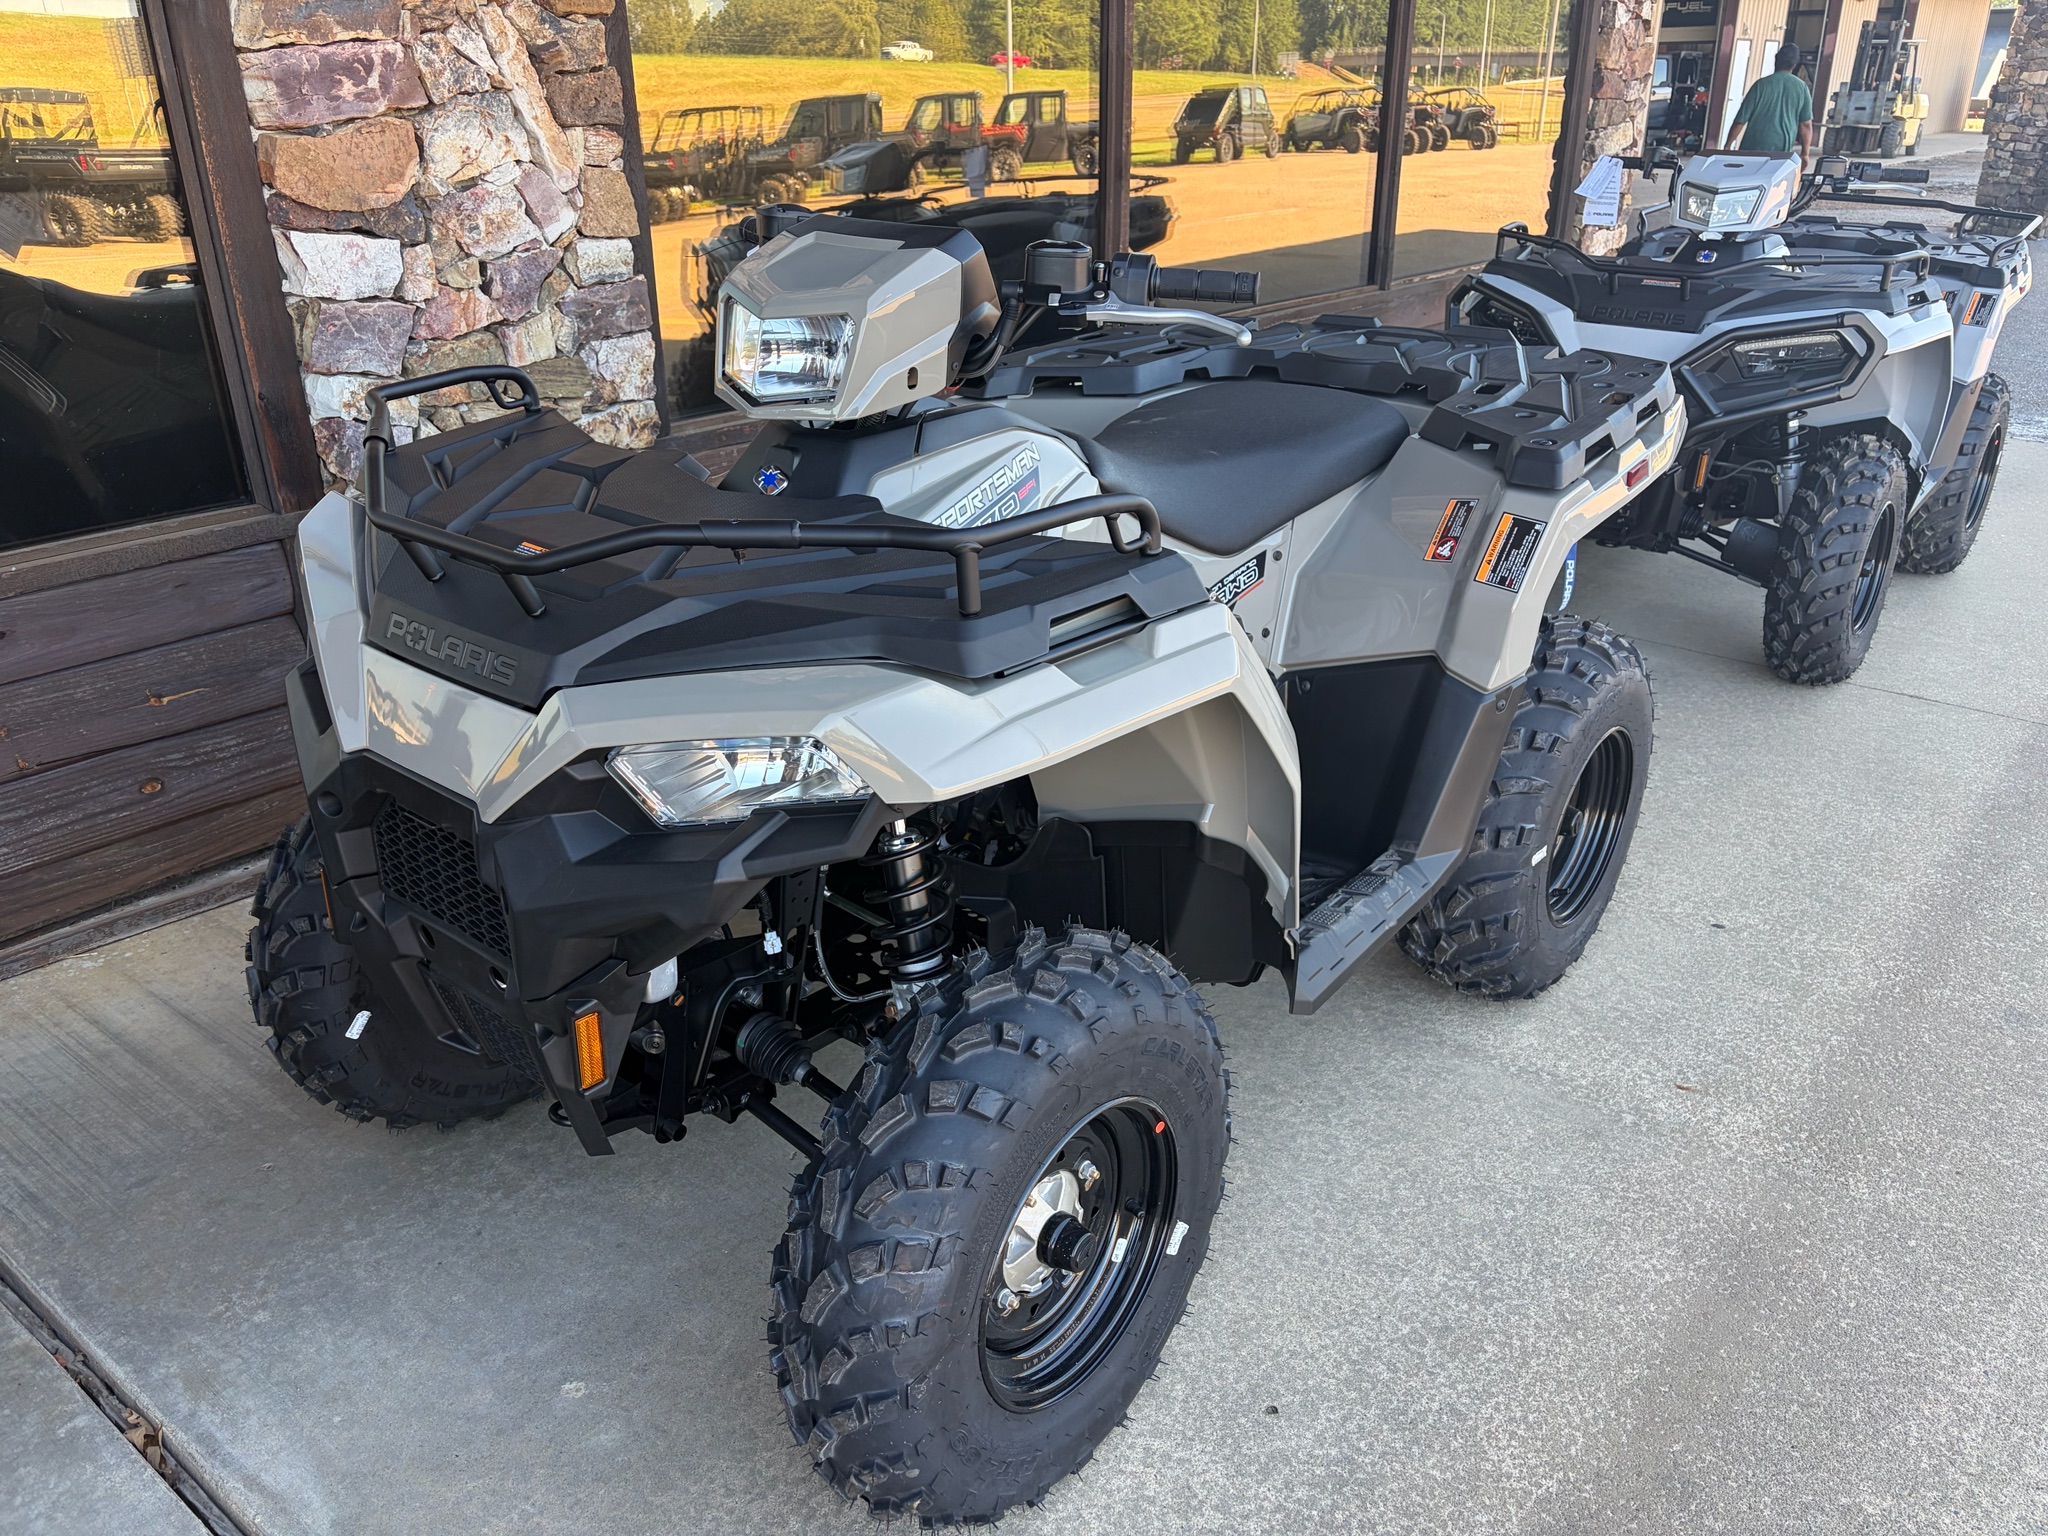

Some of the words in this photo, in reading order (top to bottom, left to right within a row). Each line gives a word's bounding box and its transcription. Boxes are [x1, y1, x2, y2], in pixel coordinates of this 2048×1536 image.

[1592, 305, 1686, 325] POLARIS
[1018, 478, 1036, 499] EFI
[1488, 529, 1505, 558] WARNING
[385, 612, 519, 687] POLARIS
